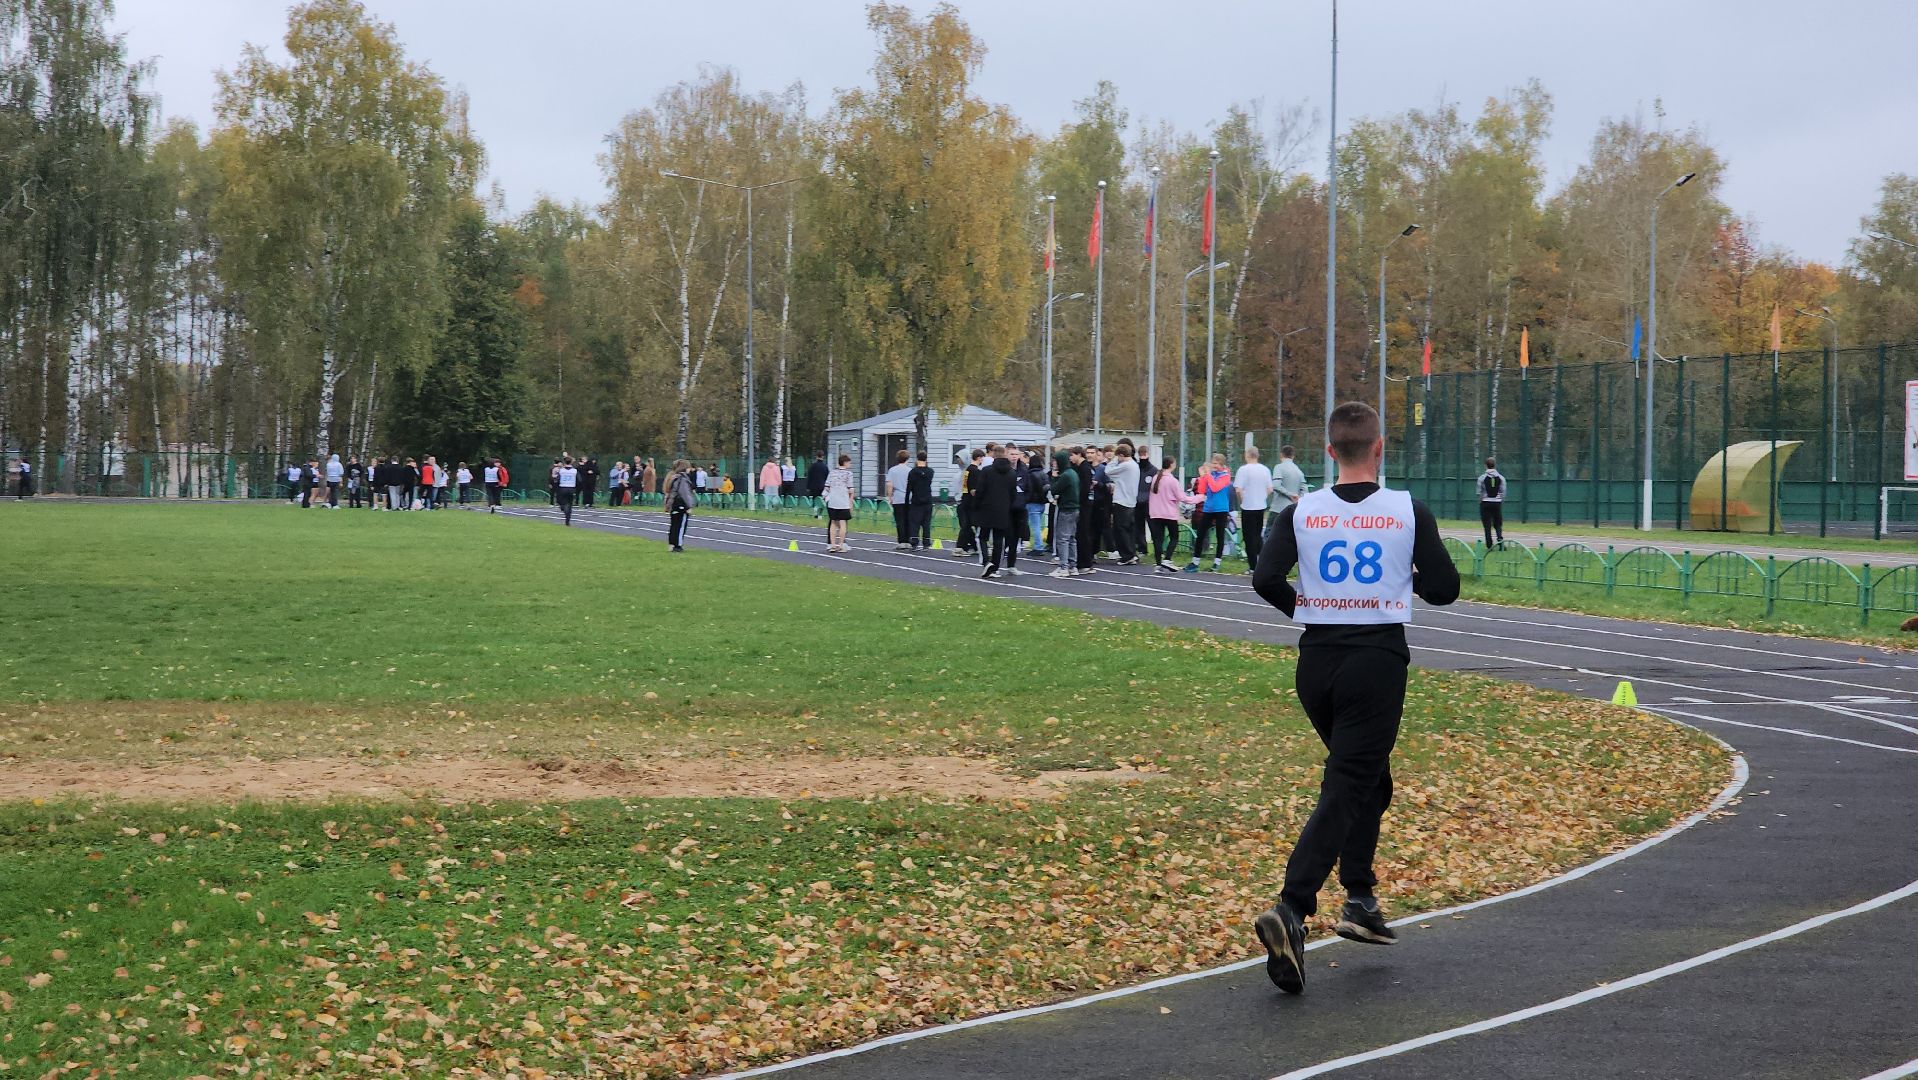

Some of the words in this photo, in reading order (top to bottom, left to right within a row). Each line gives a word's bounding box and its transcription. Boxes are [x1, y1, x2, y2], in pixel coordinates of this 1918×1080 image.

[1305, 515, 1339, 529] МБУ
[1343, 515, 1403, 530] «СШОР»
[1319, 539, 1383, 585] 68
[1296, 594, 1380, 611] Богородский
